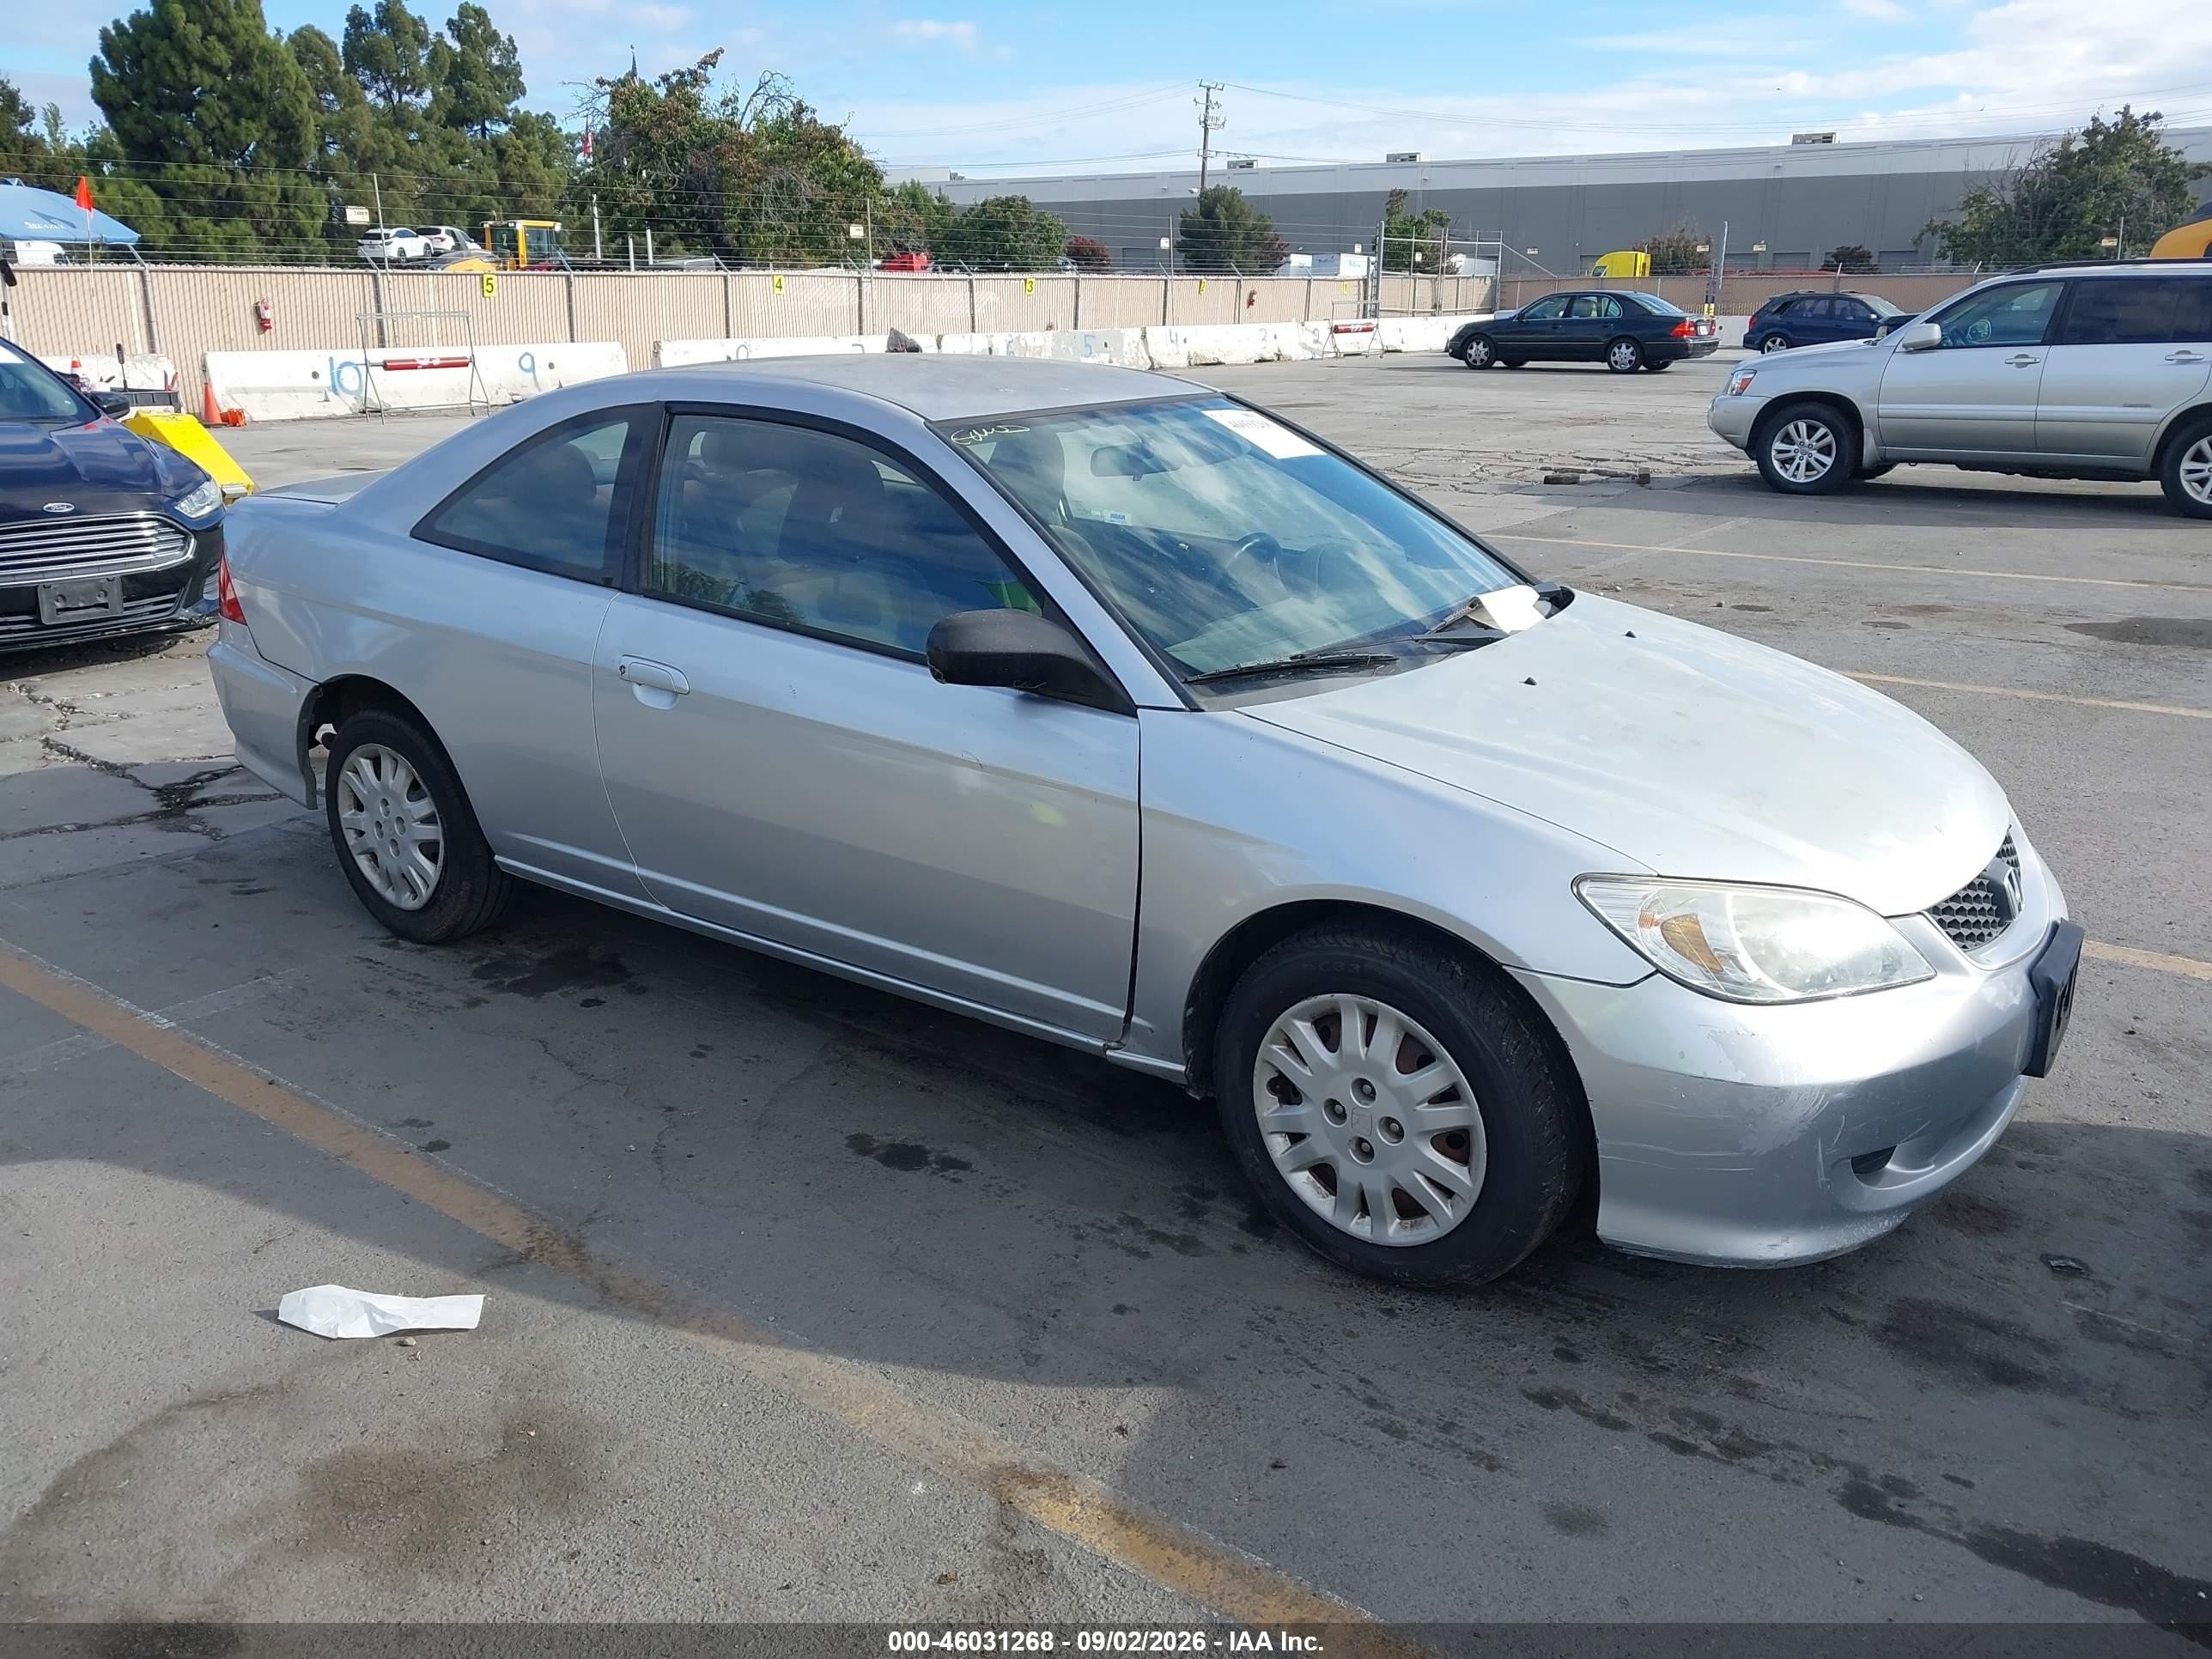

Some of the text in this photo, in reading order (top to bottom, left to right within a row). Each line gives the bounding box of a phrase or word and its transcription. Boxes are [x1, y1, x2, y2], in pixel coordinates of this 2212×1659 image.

[485, 276, 495, 294] 5
[775, 276, 783, 292] 4
[1027, 280, 1034, 293] 3
[1084, 334, 1097, 358] 5
[329, 356, 363, 397] 10
[518, 352, 542, 392] 9
